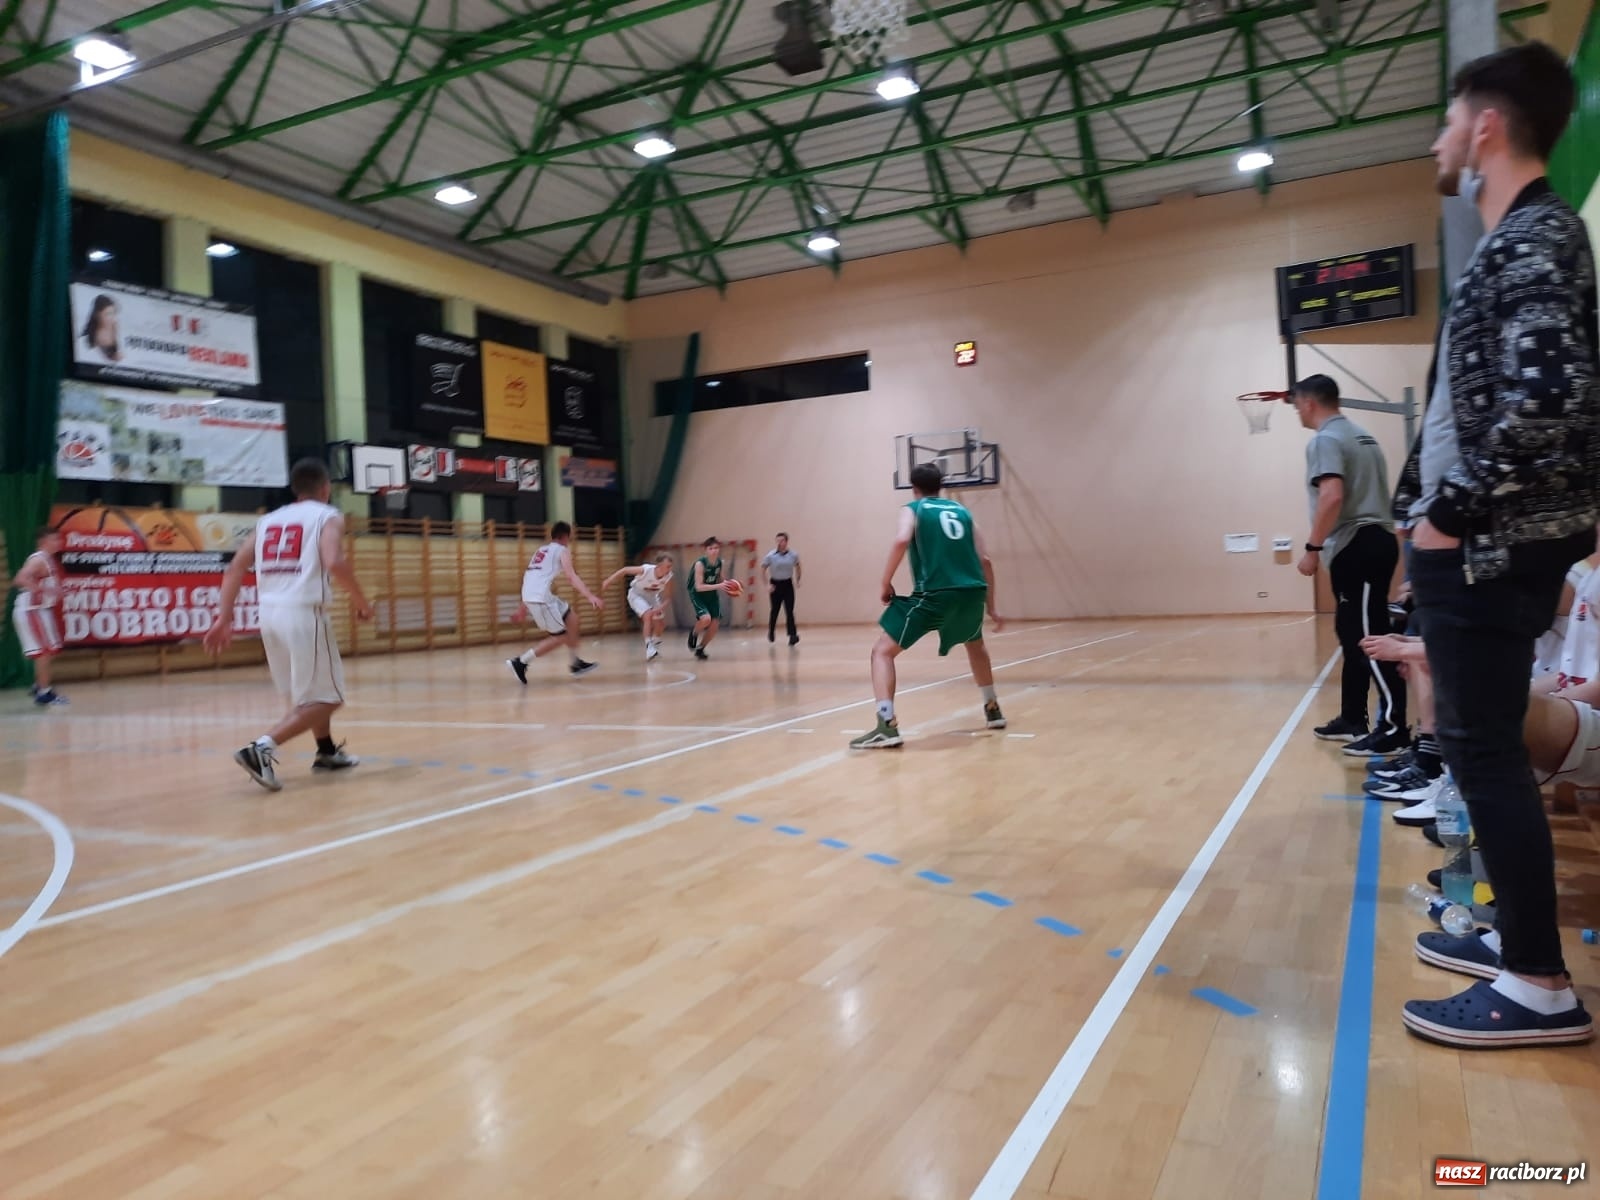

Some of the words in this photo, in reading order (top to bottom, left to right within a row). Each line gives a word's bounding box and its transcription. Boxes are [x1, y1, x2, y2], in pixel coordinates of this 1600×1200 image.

[939, 510, 965, 540] 6
[262, 524, 304, 562] 23
[63, 587, 172, 612] MIASTO
[174, 587, 187, 608] I
[64, 606, 260, 641] DOBRODIE
